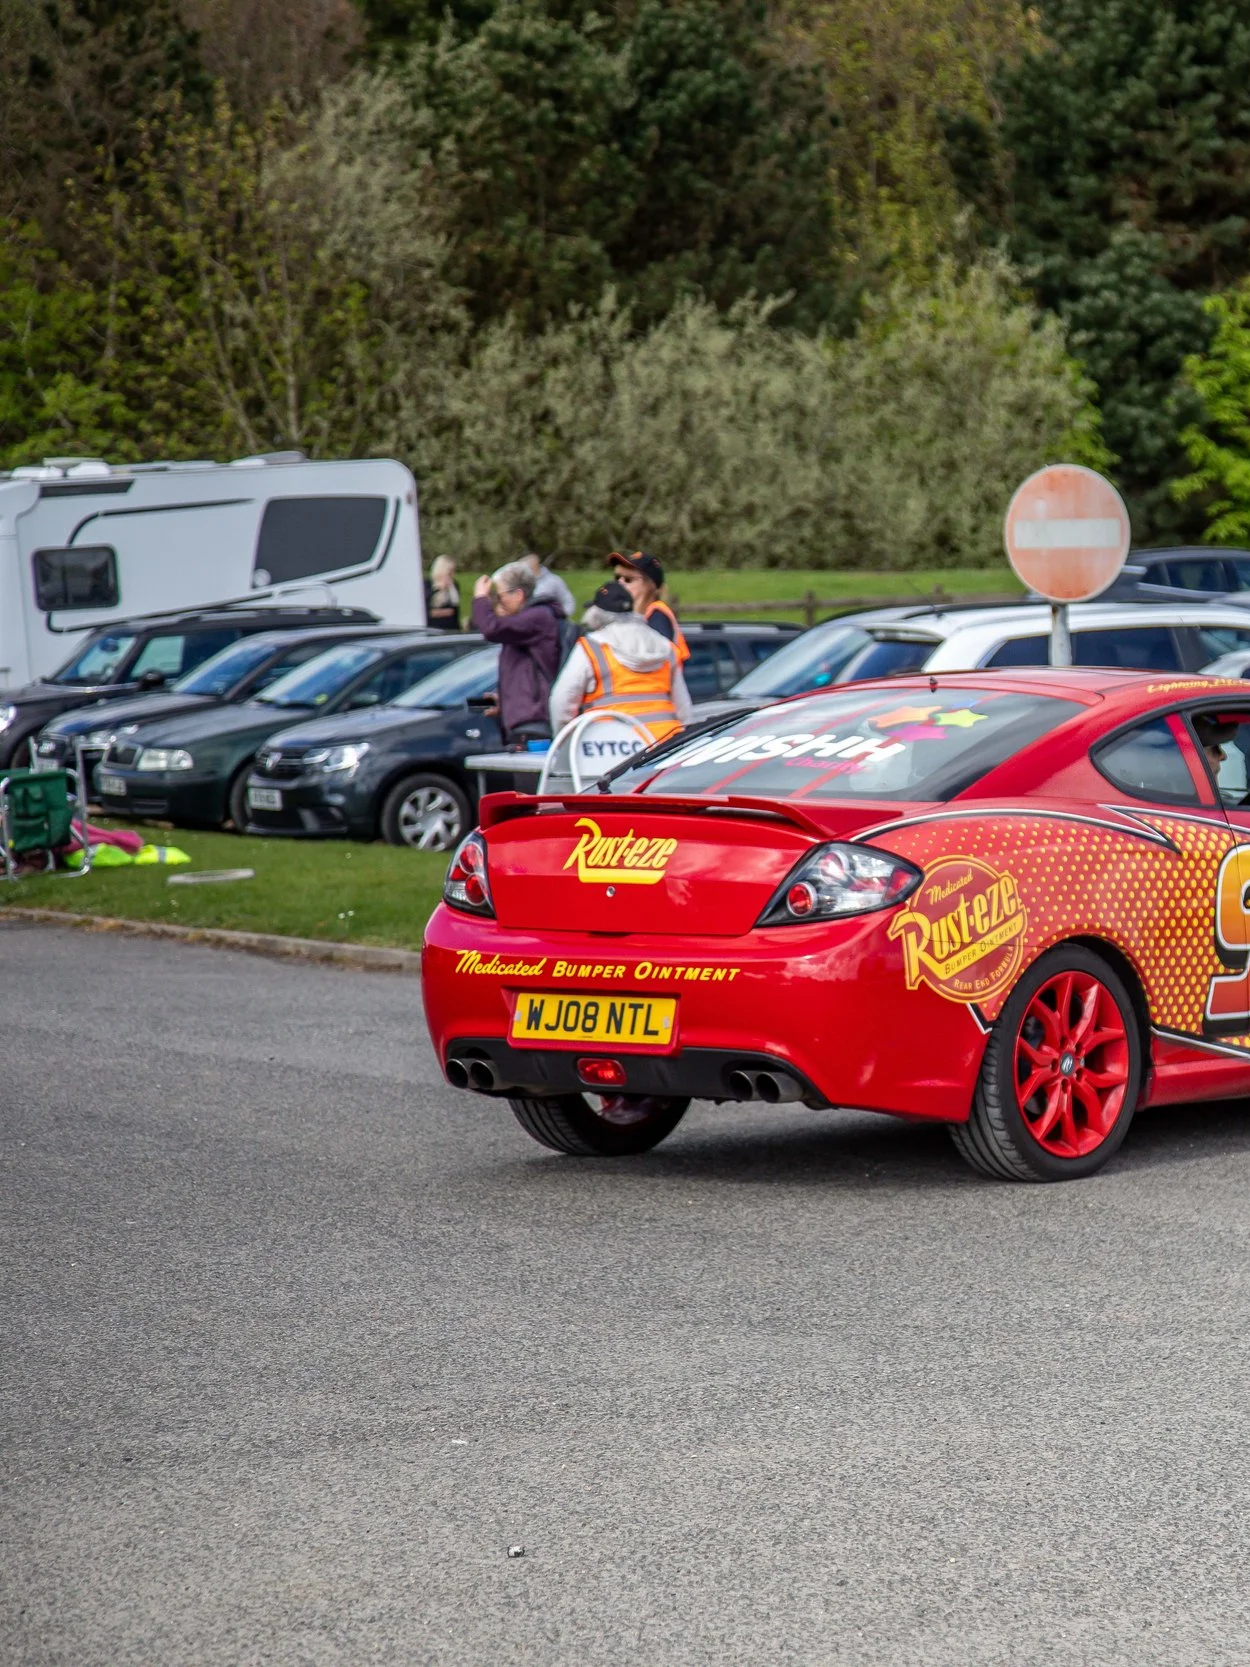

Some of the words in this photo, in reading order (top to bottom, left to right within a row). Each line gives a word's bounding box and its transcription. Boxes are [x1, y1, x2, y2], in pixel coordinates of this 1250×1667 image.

[582, 740, 643, 756] EYTCC
[654, 733, 906, 770] WISHH
[925, 868, 974, 905] Medicated
[455, 950, 547, 976] Medicated
[552, 960, 626, 979] BUMPER
[634, 961, 740, 982] OINTMENT
[944, 950, 977, 975] BUMPER
[979, 922, 1018, 952] OINTMENT
[953, 978, 973, 991] REAR
[975, 979, 990, 990] END
[990, 945, 1014, 981] FORMULA
[526, 998, 600, 1033] WJ08
[606, 1001, 659, 1036] NTL
